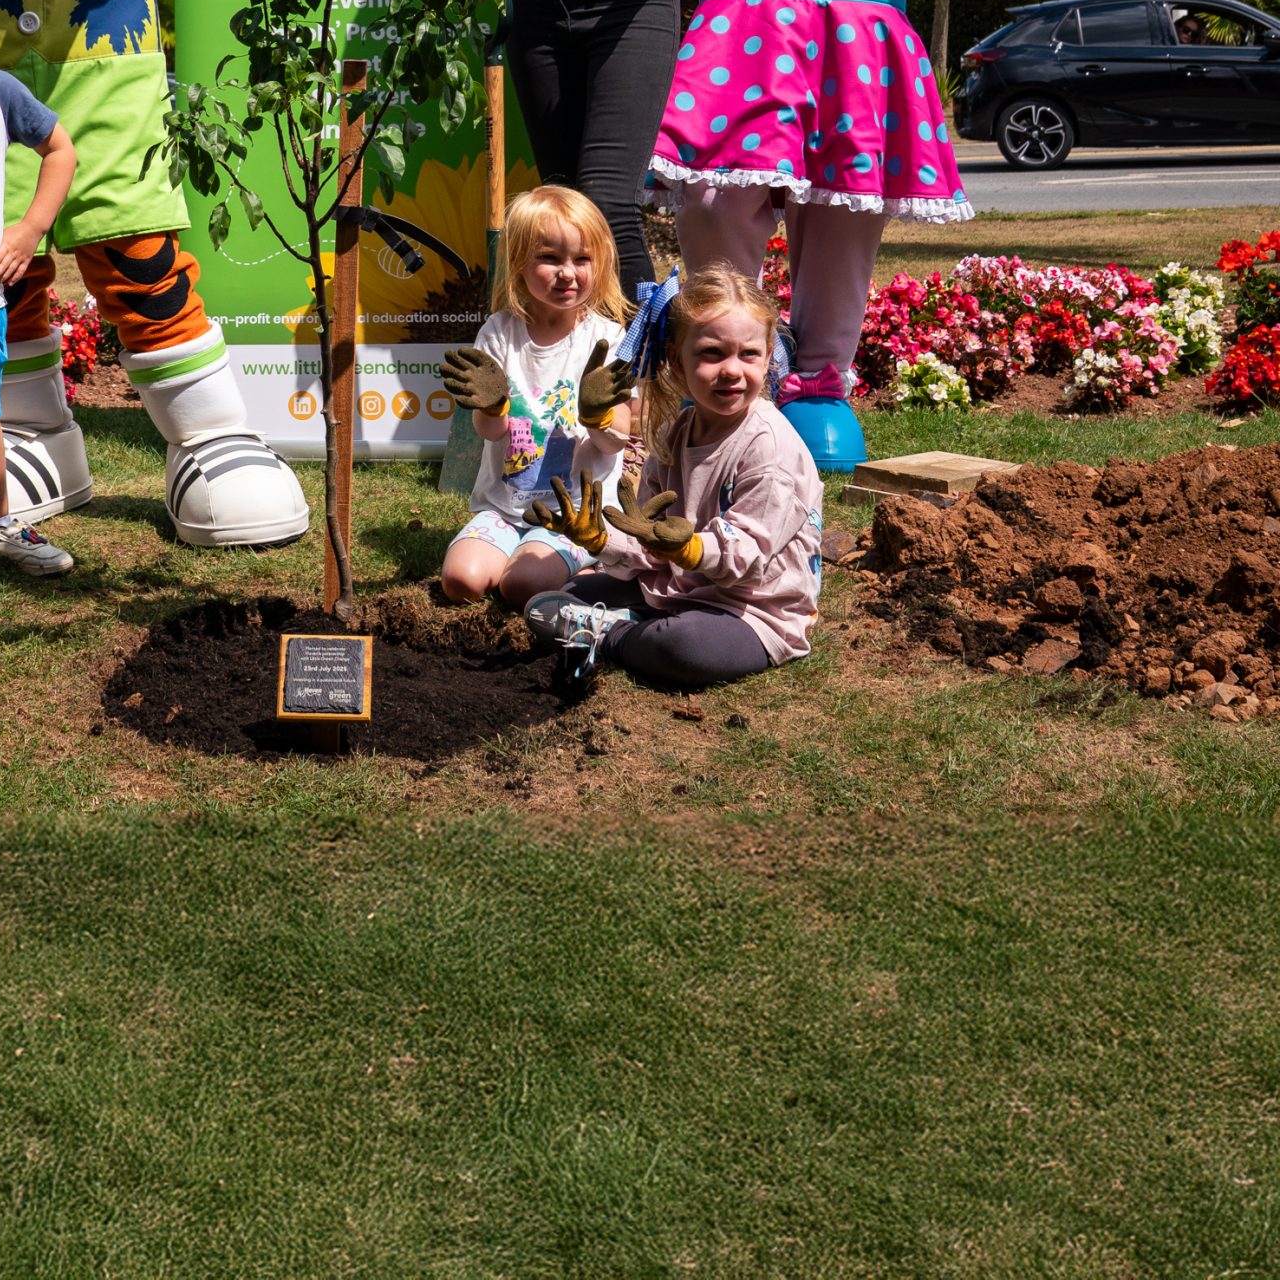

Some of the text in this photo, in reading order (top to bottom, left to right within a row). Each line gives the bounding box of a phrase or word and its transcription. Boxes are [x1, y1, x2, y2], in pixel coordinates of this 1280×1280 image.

[372, 311, 439, 323] education
[442, 311, 481, 323] social
[319, 665, 332, 673] July
